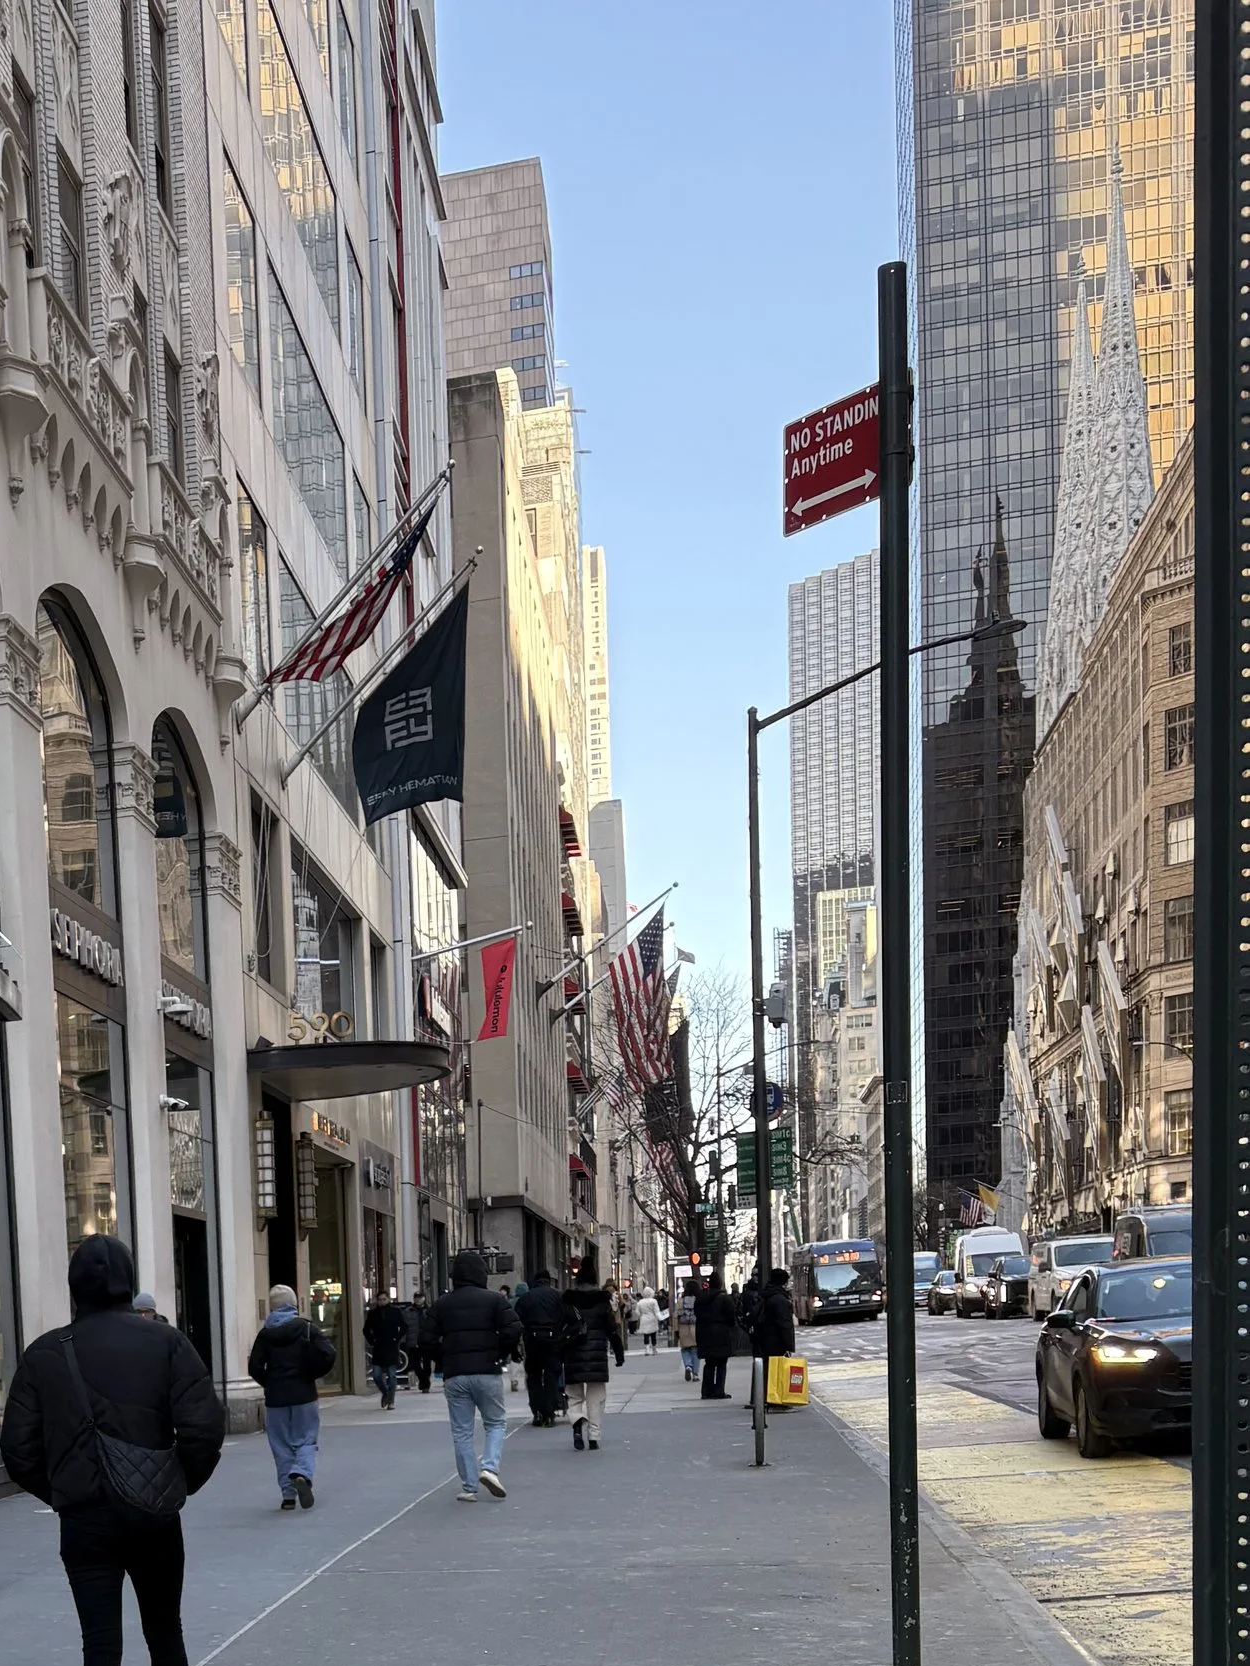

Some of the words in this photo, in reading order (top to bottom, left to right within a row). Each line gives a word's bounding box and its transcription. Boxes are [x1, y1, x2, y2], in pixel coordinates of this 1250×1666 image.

[790, 427, 811, 454] NO
[815, 395, 879, 442] STANDIN
[791, 438, 853, 479] Anytime
[49, 908, 124, 987] SEPHORA
[287, 1011, 355, 1041] 590
